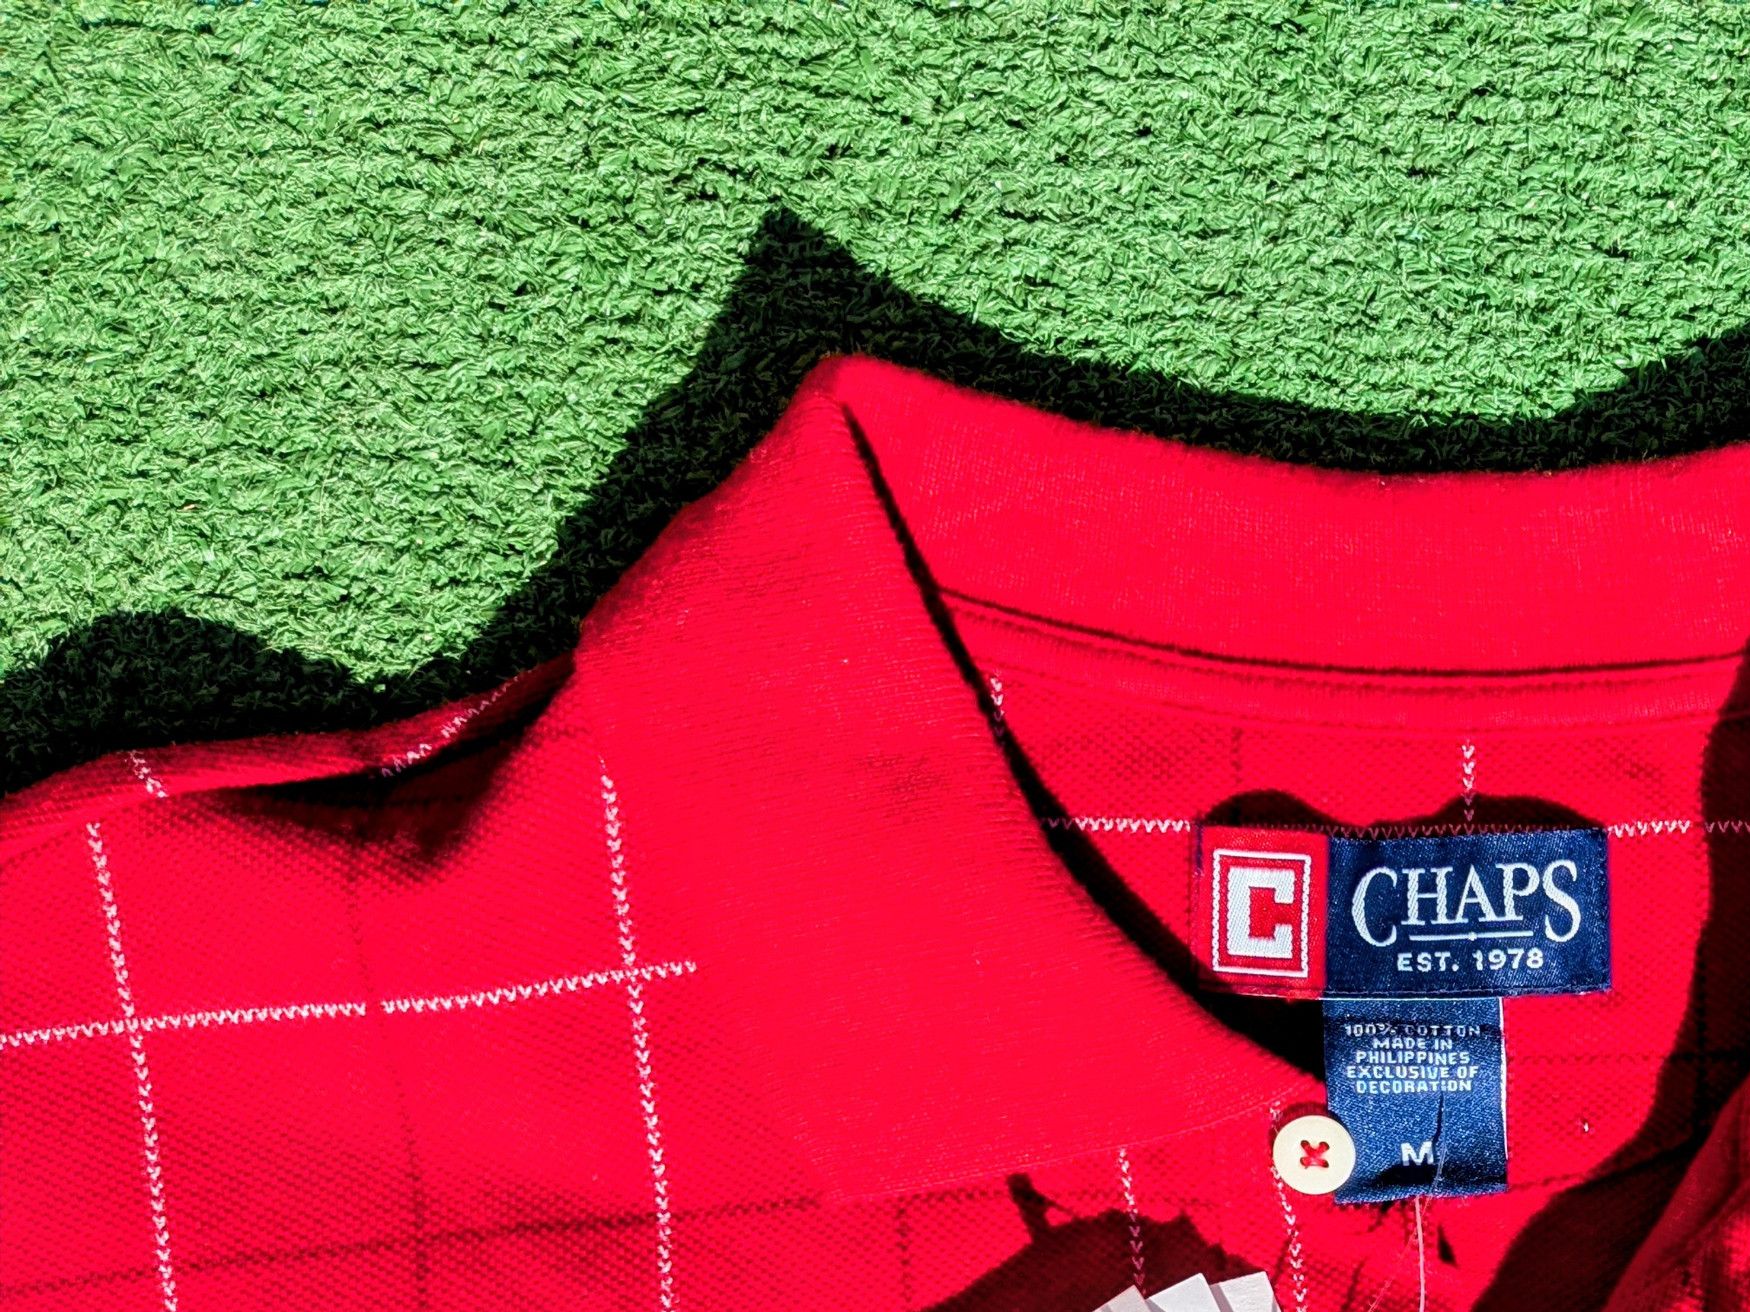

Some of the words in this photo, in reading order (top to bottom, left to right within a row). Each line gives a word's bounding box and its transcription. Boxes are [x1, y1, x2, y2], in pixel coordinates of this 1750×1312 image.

[1351, 859, 1582, 948] CHAPS
[1227, 867, 1295, 958] C
[1397, 951, 1460, 972] EST.
[1472, 948, 1544, 971] 1978
[1345, 1022, 1398, 1037] 100%
[1404, 1024, 1481, 1038] COTTON
[1372, 1037, 1427, 1050] MADE
[1434, 1038, 1453, 1051] IN
[1355, 1051, 1471, 1065] PHILIPPINES
[1346, 1065, 1450, 1079] EXCLUSIVE
[1456, 1065, 1479, 1079] OF
[1356, 1080, 1473, 1094] DECORATION
[1401, 1141, 1435, 1167] M
